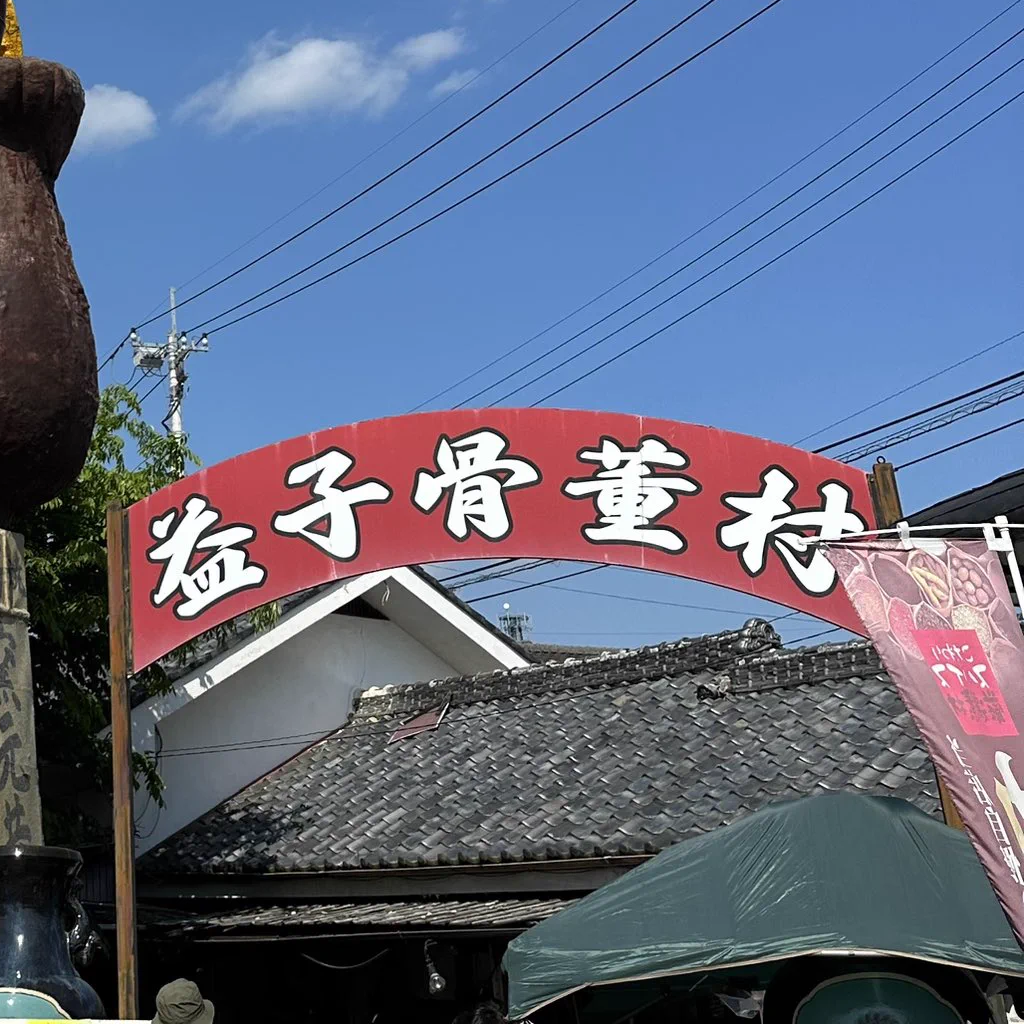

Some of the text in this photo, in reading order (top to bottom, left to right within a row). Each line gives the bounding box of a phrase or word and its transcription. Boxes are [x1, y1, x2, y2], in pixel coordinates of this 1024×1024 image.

[147, 427, 868, 620] 益子骨董村
